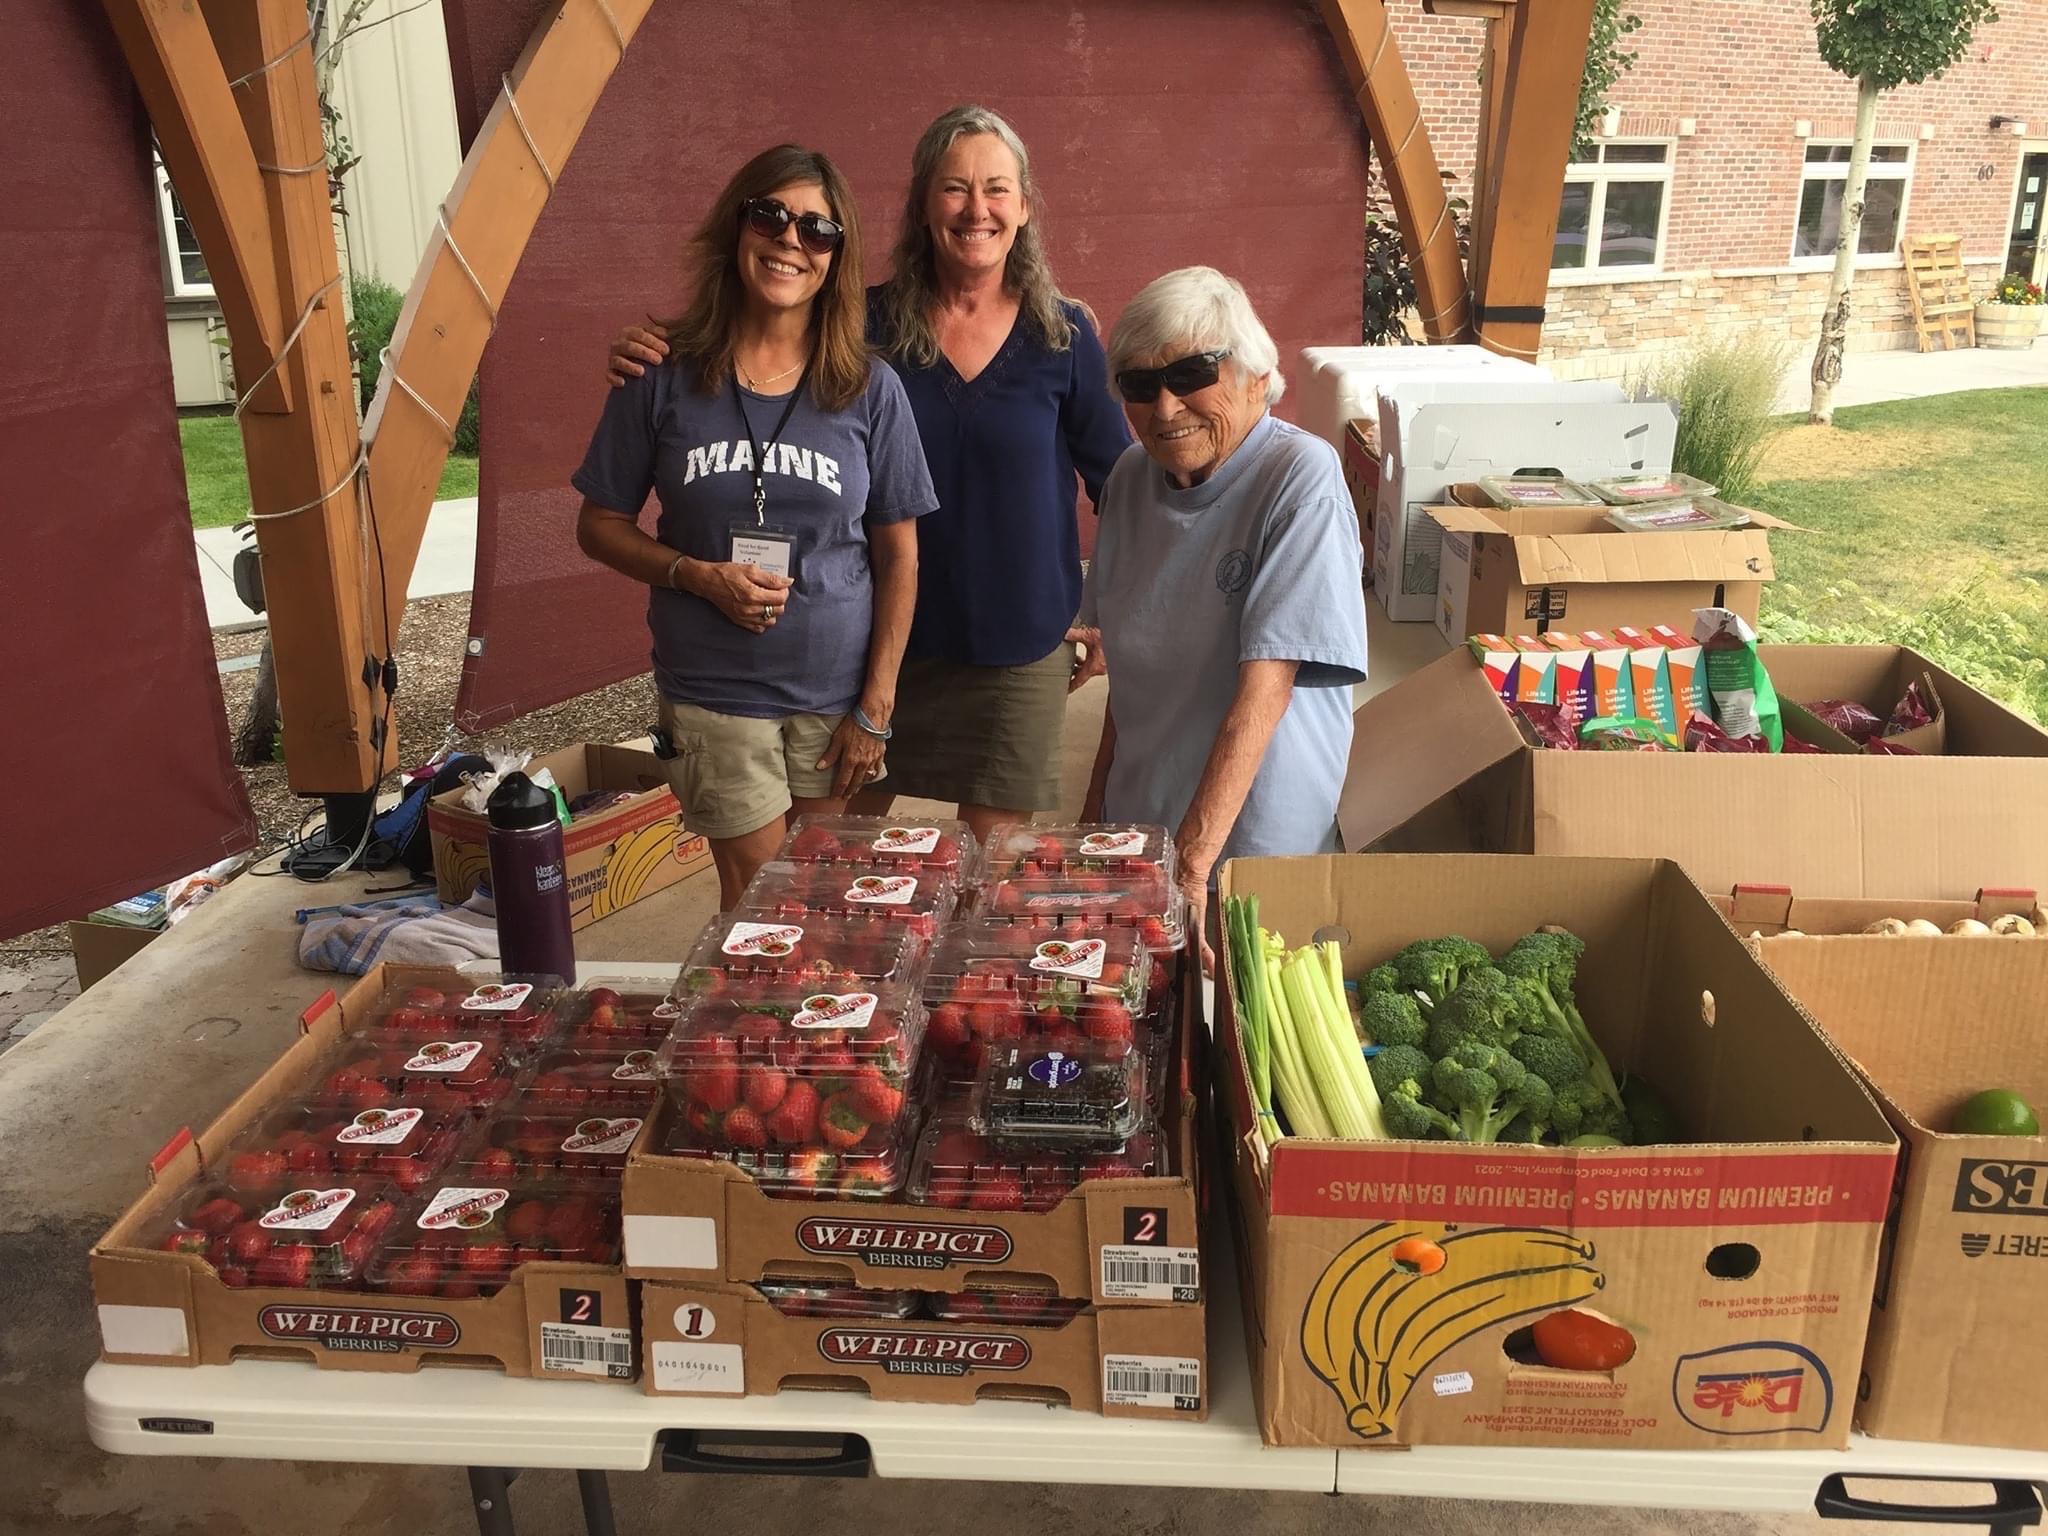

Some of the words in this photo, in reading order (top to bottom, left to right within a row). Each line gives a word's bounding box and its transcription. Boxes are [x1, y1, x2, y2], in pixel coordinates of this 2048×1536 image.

[1977, 164, 1995, 180] 60
[683, 440, 842, 496] MAINE
[1566, 689, 1579, 697] Life
[1680, 686, 1694, 694] Life
[1604, 695, 1627, 704] better
[1643, 694, 1665, 703] better
[1681, 693, 1703, 702] better
[1607, 703, 1627, 711] when
[1645, 702, 1665, 710] when
[677, 838, 704, 859] Dole
[1475, 1164, 1503, 1175] 2021
[1531, 1164, 1589, 1179] Company,
[1591, 1167, 1621, 1178] Food
[1622, 1166, 1648, 1177] Dole
[1329, 1181, 1447, 1205] BANANAS
[1455, 1184, 1575, 1210] PREMIUM
[1718, 1184, 1833, 1210] PREMIUM
[1594, 1187, 1711, 1211] BANANAS
[1133, 1211, 1158, 1241] 2
[869, 1252, 945, 1268] BERRIES
[1180, 1288, 1196, 1301] 28
[1776, 1294, 1819, 1305] WEIGHT:
[1821, 1294, 1840, 1303] NET
[1747, 1296, 1760, 1305] lbs
[1762, 1296, 1774, 1305] 40
[570, 1295, 593, 1321] 2
[1727, 1307, 1776, 1320] ECUADOR
[1776, 1306, 1789, 1317] OF
[1791, 1305, 1839, 1315] PRODUCT
[685, 1306, 703, 1337] 1
[328, 1336, 400, 1352] BERRIES
[615, 1366, 629, 1378] 28
[889, 1360, 964, 1376] BERRIES
[1506, 1380, 1560, 1389] FRESHNESS
[1561, 1381, 1614, 1390] MAINTAIN
[1614, 1383, 1628, 1391] TO
[1693, 1376, 1803, 1418] Dole
[1183, 1397, 1195, 1409] 71
[1534, 1407, 1552, 1415] NC
[1554, 1408, 1624, 1417] CHARLOTTE,
[1464, 1415, 1534, 1427] COMPANY
[1537, 1416, 1575, 1427] FRUIT
[1577, 1417, 1620, 1427] FRESH
[1622, 1417, 1657, 1428] DOLE
[1505, 1424, 1563, 1435] Dispatched
[1573, 1426, 1632, 1437] Distributed
